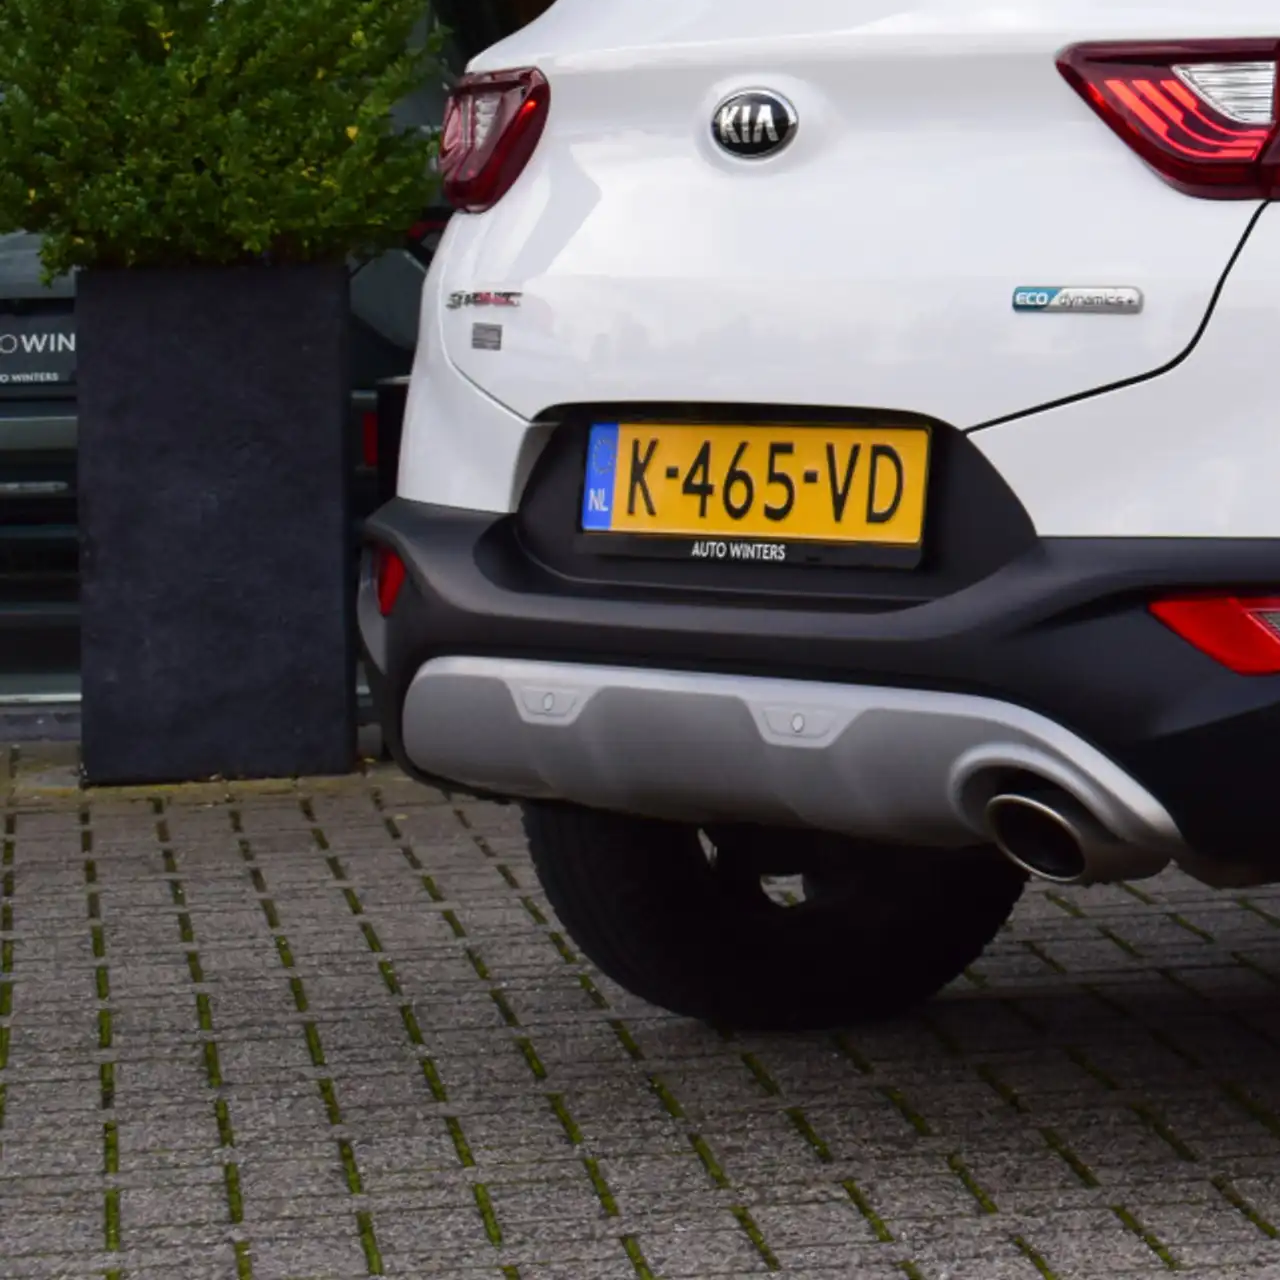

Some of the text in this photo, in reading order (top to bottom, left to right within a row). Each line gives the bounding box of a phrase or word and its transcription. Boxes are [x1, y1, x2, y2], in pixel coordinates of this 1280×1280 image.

[719, 103, 780, 144] KIA
[1015, 291, 1049, 306] ECO
[626, 438, 905, 525] K-465-VD
[588, 488, 609, 511] NL
[691, 540, 786, 560] AUTO WINTERS
